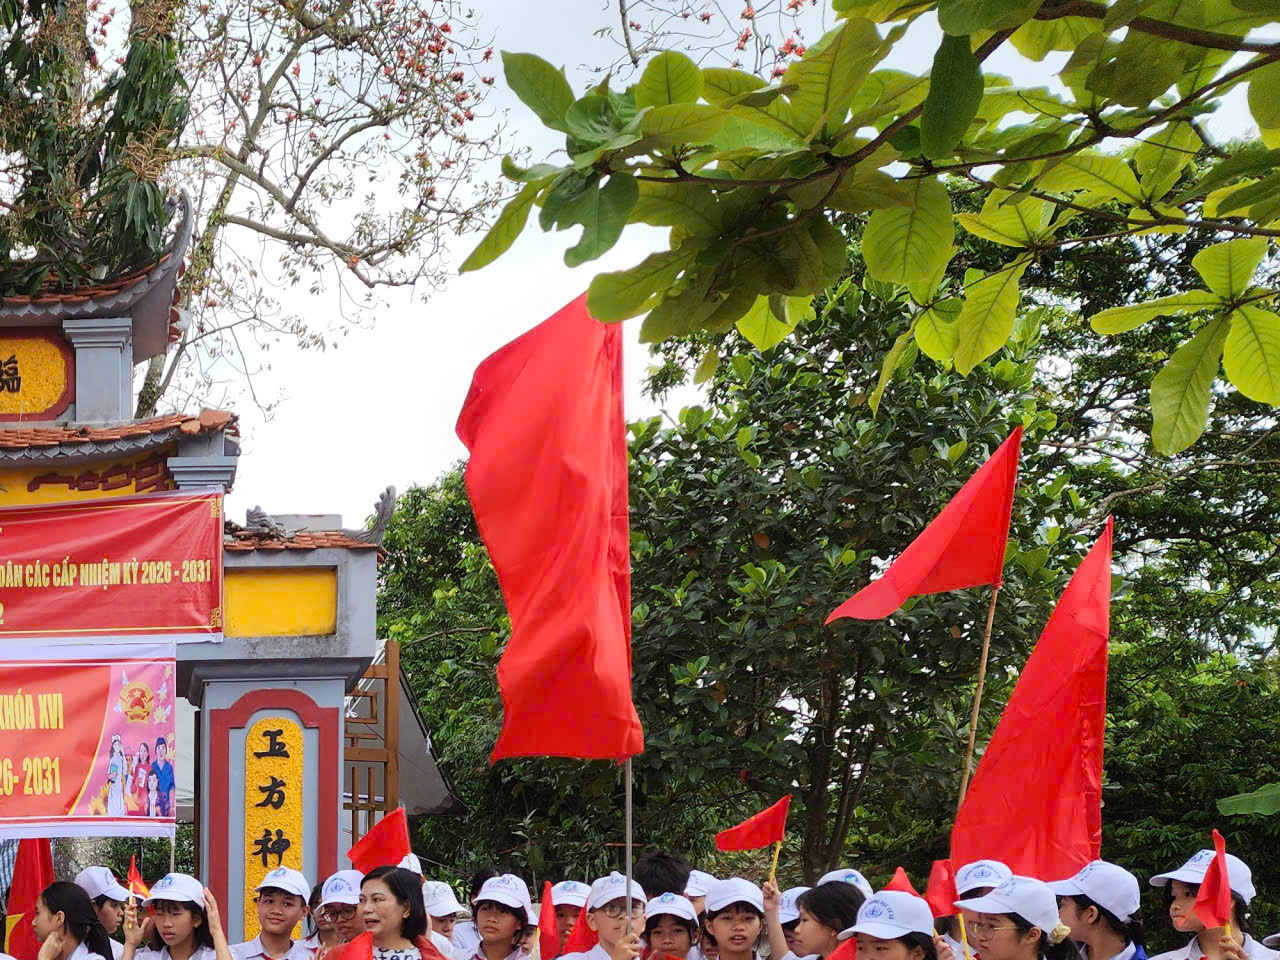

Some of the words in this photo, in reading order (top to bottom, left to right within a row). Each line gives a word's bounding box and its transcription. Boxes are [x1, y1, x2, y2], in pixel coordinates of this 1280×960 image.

[25, 559, 50, 588] CÁC
[52, 555, 78, 587] CẤP
[80, 558, 120, 591] NHIỆM
[122, 557, 139, 585] KỲ
[141, 560, 172, 584] 2026
[181, 559, 211, 583] 2031
[37, 692, 64, 730] XVI
[22, 756, 61, 796] 2031
